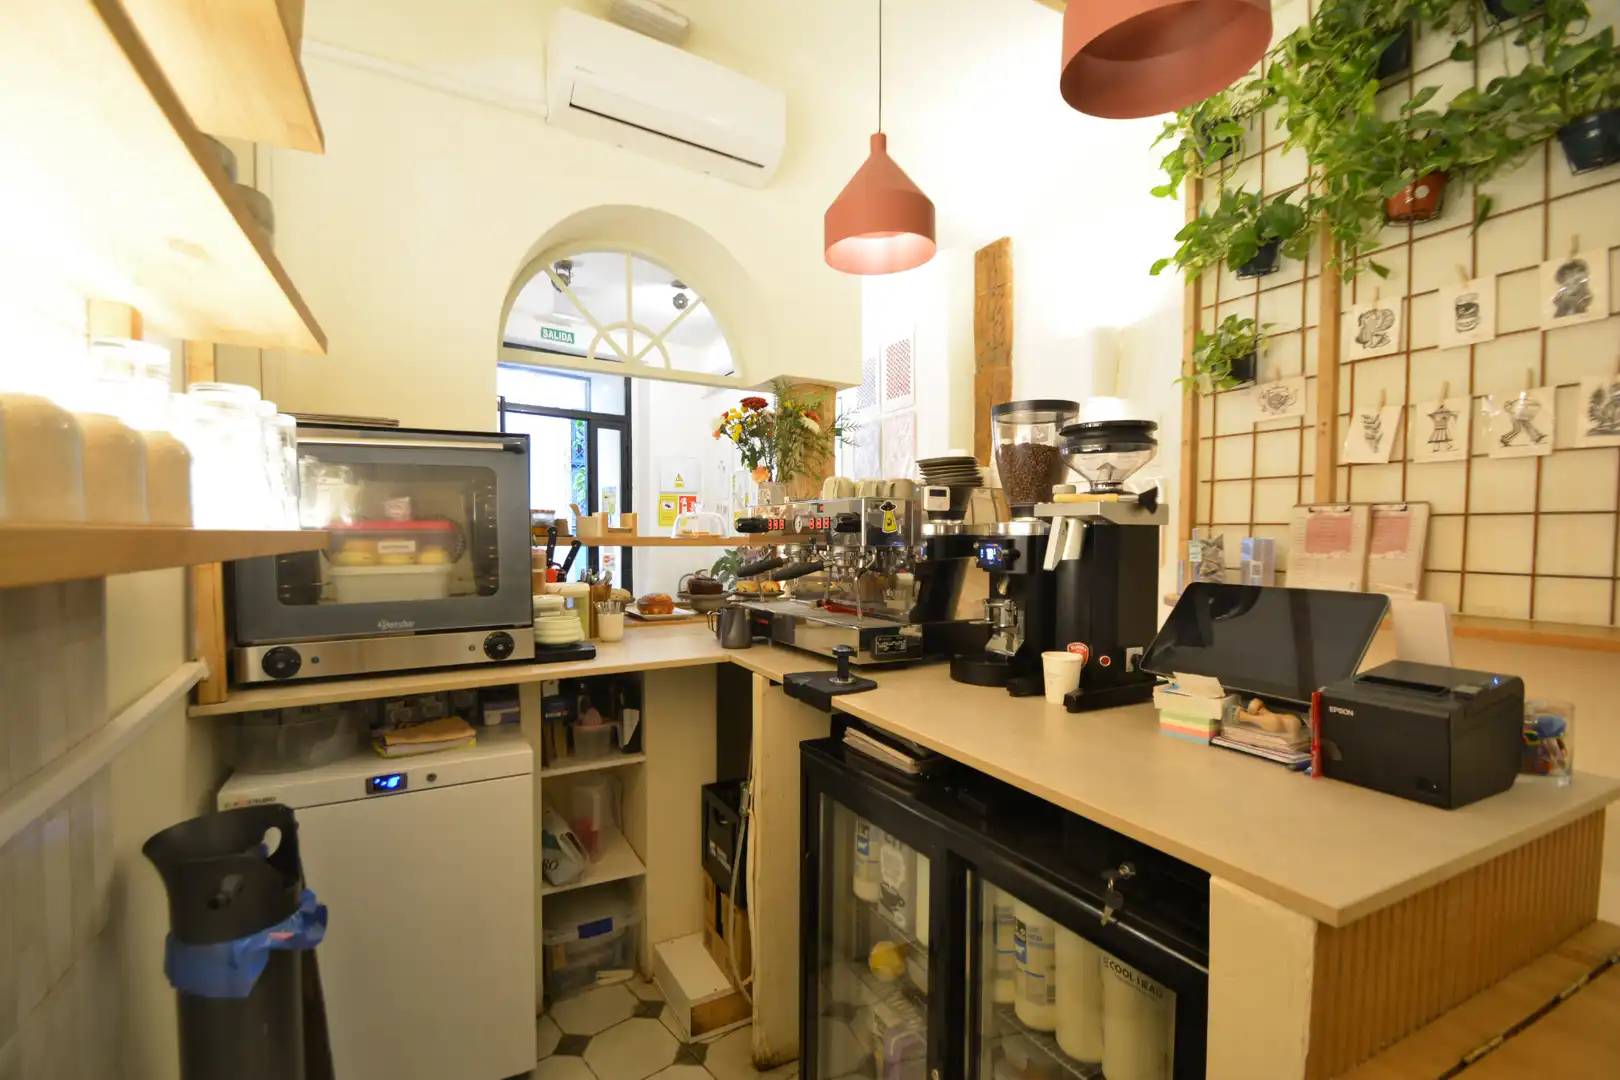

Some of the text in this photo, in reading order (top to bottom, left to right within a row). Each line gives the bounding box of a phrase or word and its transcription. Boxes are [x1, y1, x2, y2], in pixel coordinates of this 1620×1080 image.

[542, 328, 573, 343] SALIDA
[1328, 705, 1354, 717] EPSON
[1108, 959, 1134, 982] COOL
